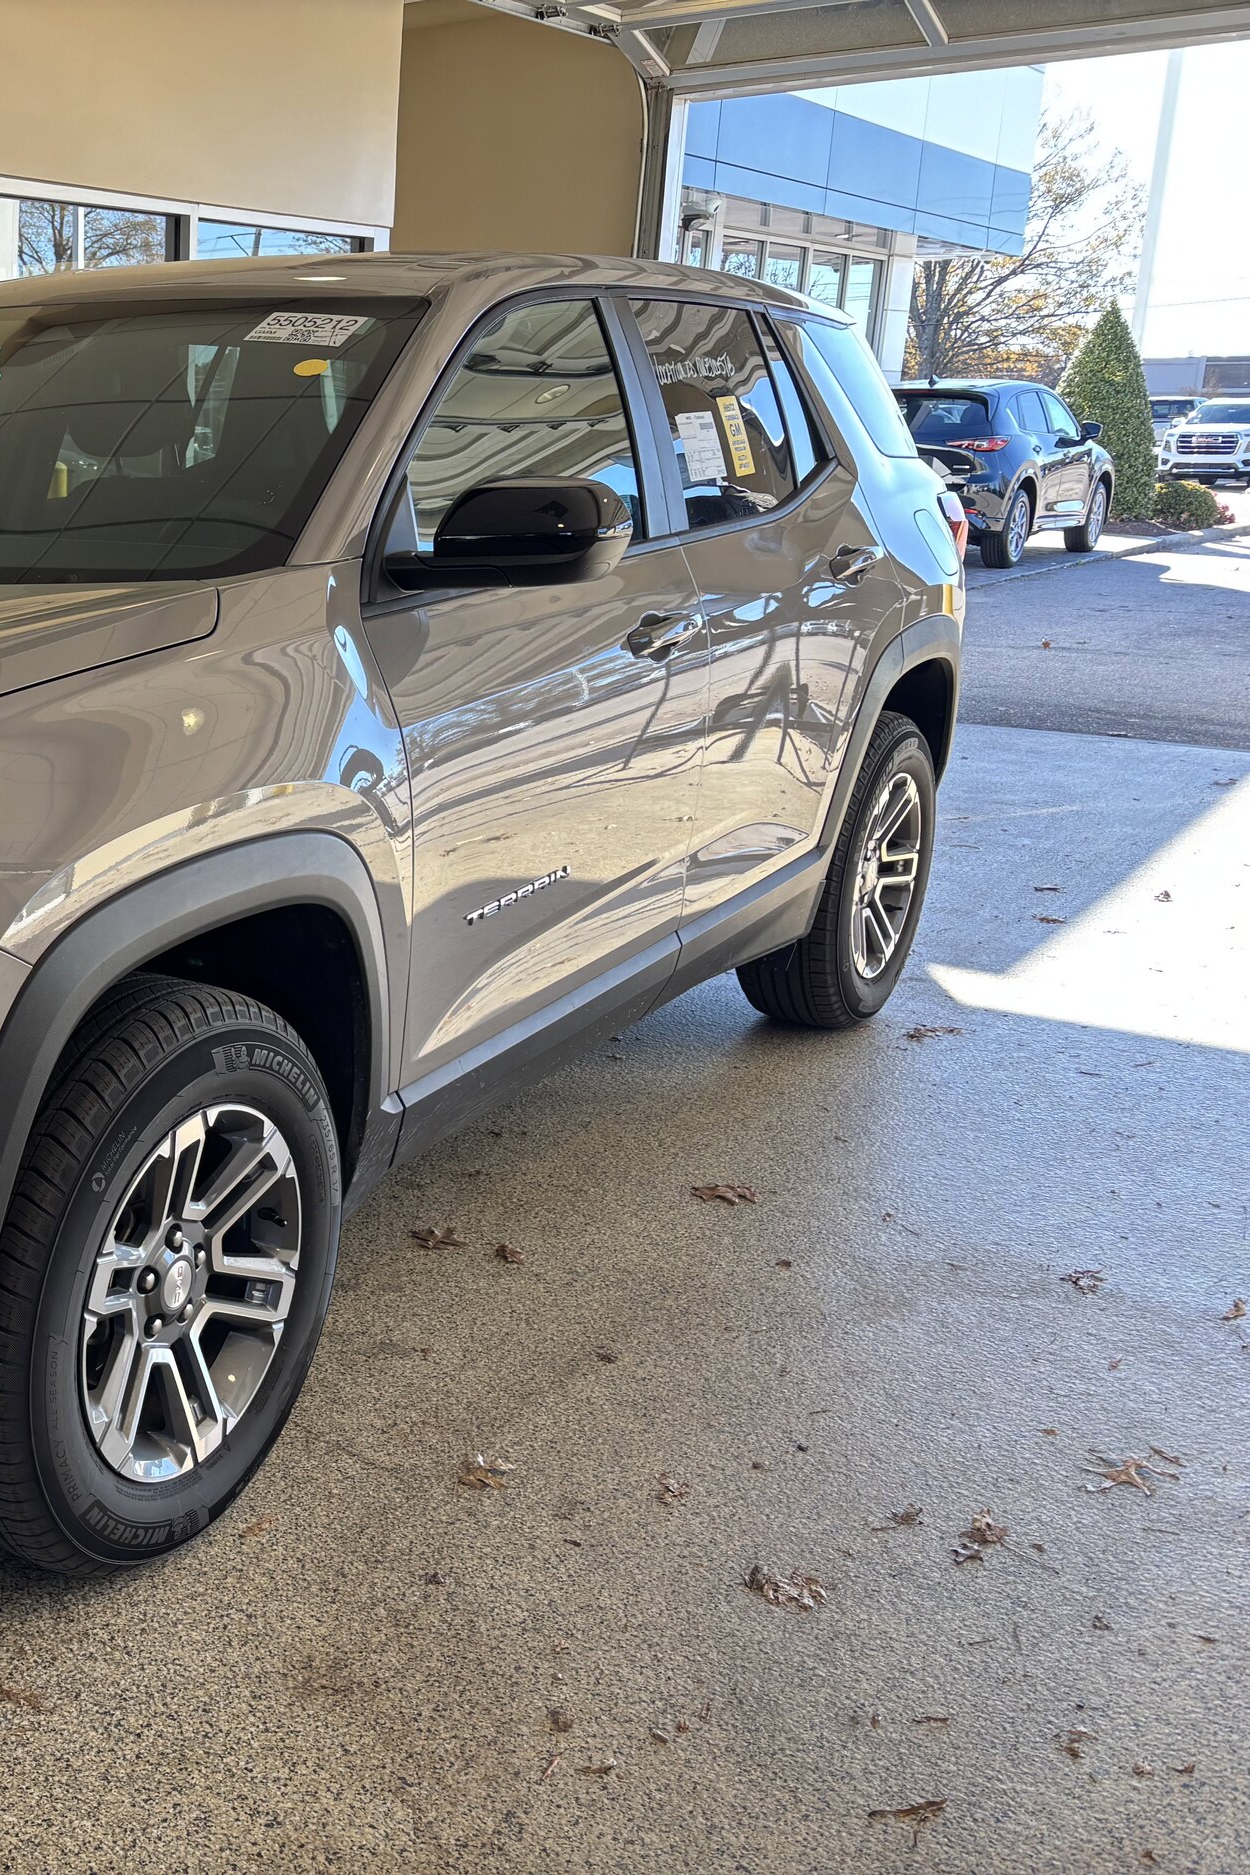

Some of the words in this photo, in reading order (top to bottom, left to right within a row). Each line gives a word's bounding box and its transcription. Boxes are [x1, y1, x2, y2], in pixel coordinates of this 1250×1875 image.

[266, 315, 359, 331] 5505212
[729, 423, 743, 437] GM
[463, 865, 570, 925] TERRAIN
[251, 1048, 319, 1107] MICHELIN
[101, 1131, 125, 1171] MICHELIN
[321, 1115, 335, 1160] 235/65
[331, 1184, 339, 1193] 17
[173, 1265, 183, 1304] GMC
[50, 1351, 58, 1404] SEASON
[52, 1405, 60, 1430] ALL
[54, 1440, 83, 1502] PRIMACY
[86, 1506, 170, 1545] MICHELIN
